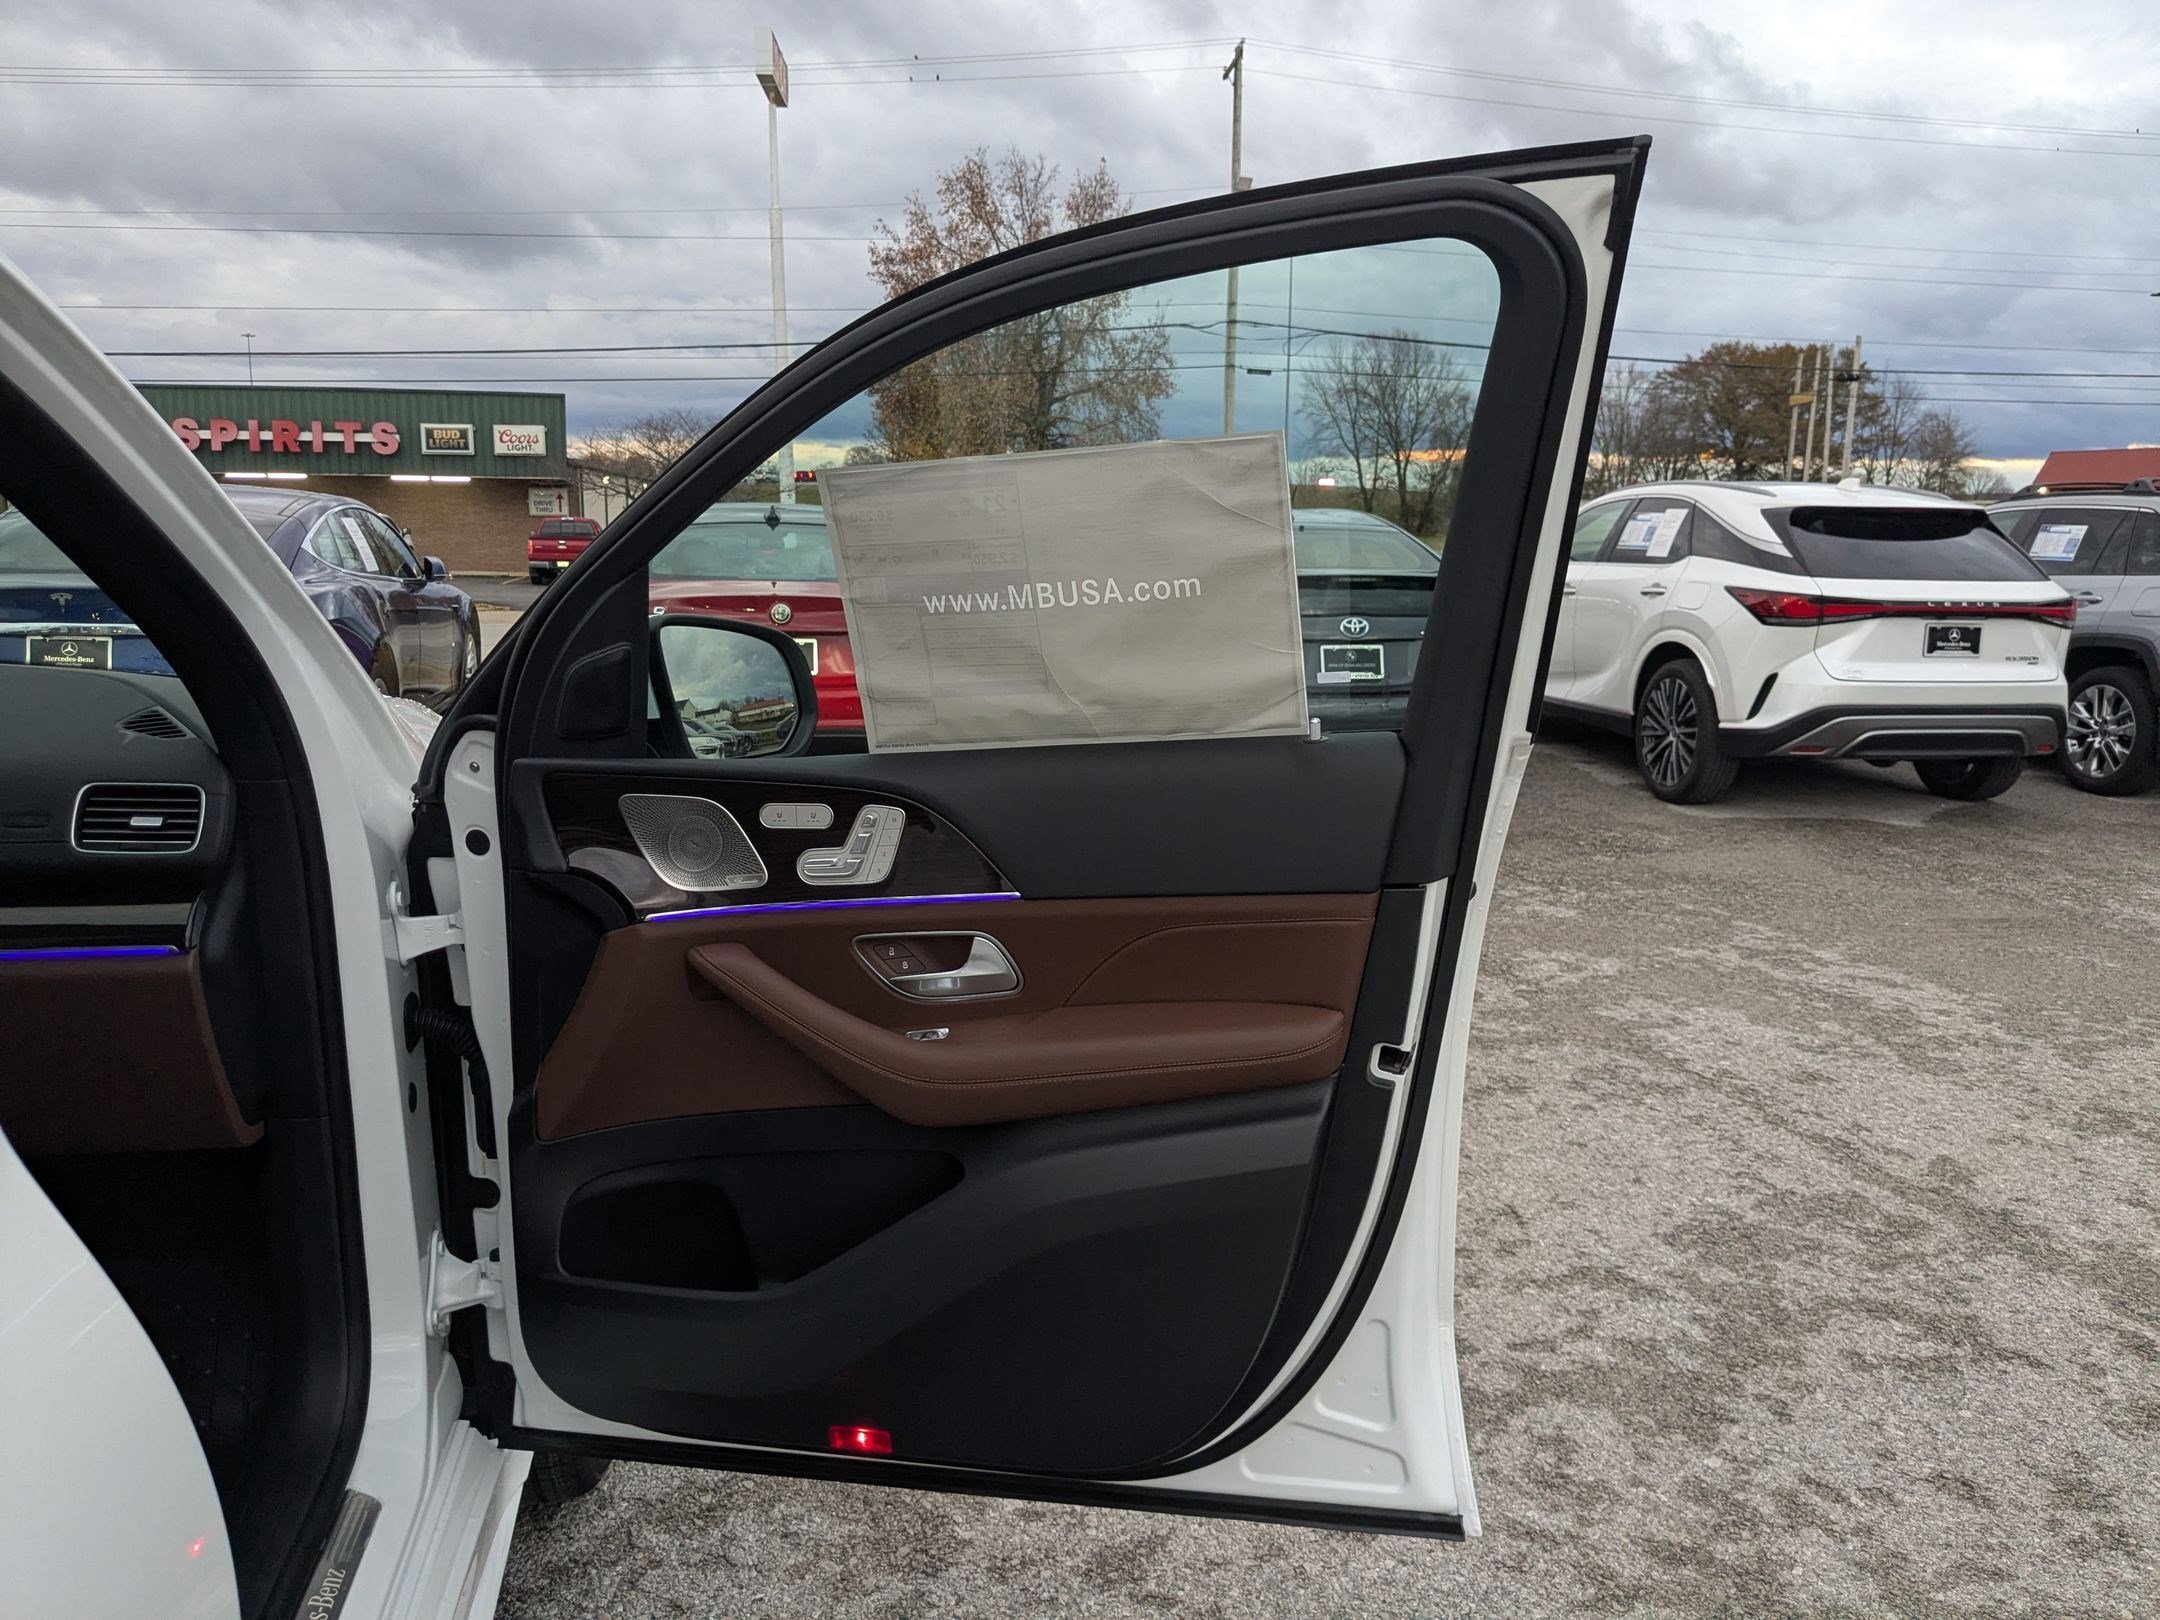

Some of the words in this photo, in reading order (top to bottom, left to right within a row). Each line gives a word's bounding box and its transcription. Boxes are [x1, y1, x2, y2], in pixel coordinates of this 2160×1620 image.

[172, 417, 399, 455] SPIRITS
[433, 430, 460, 439] BUD
[498, 429, 539, 444] Coors
[429, 439, 466, 448] LIGHT
[507, 444, 533, 452] LIGHT
[923, 577, 1202, 613] www.MBUSA.com
[43, 655, 95, 663] Mercedes-Benz
